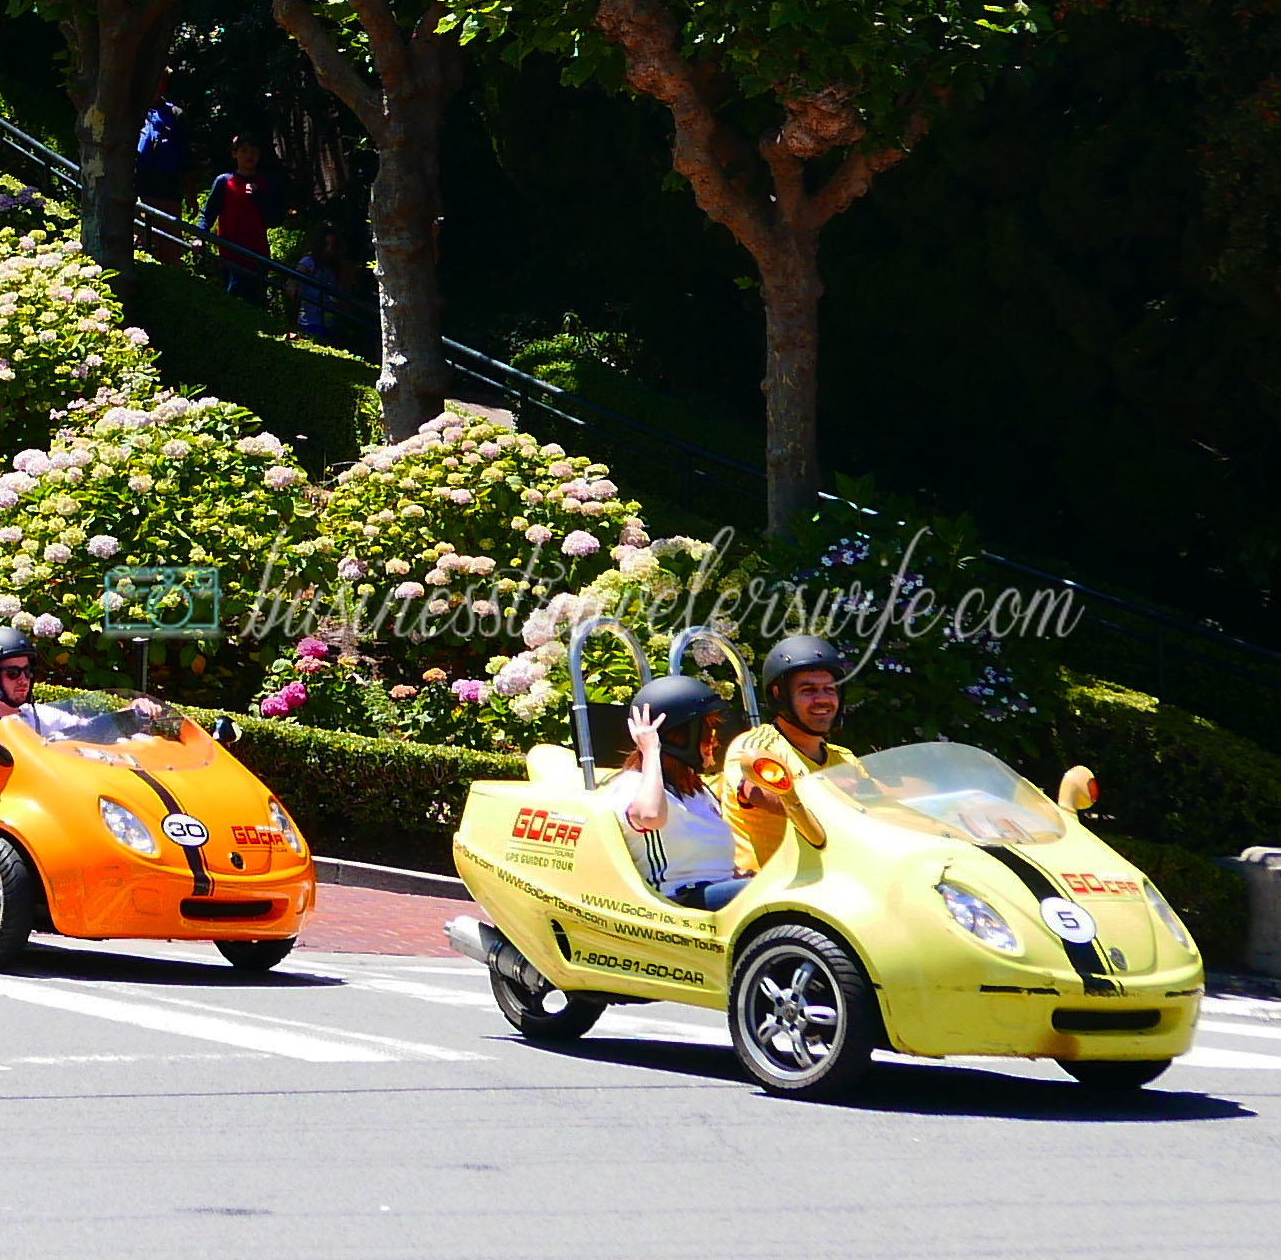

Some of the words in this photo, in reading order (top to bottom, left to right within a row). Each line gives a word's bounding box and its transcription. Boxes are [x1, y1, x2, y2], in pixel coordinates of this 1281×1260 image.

[168, 821, 205, 838] 30
[505, 852, 519, 863] GPS
[520, 854, 550, 868] GUIDED
[551, 858, 574, 872] TOUR
[1057, 911, 1080, 929] 5
[573, 949, 705, 985] 1-800-91-GO-CAR
